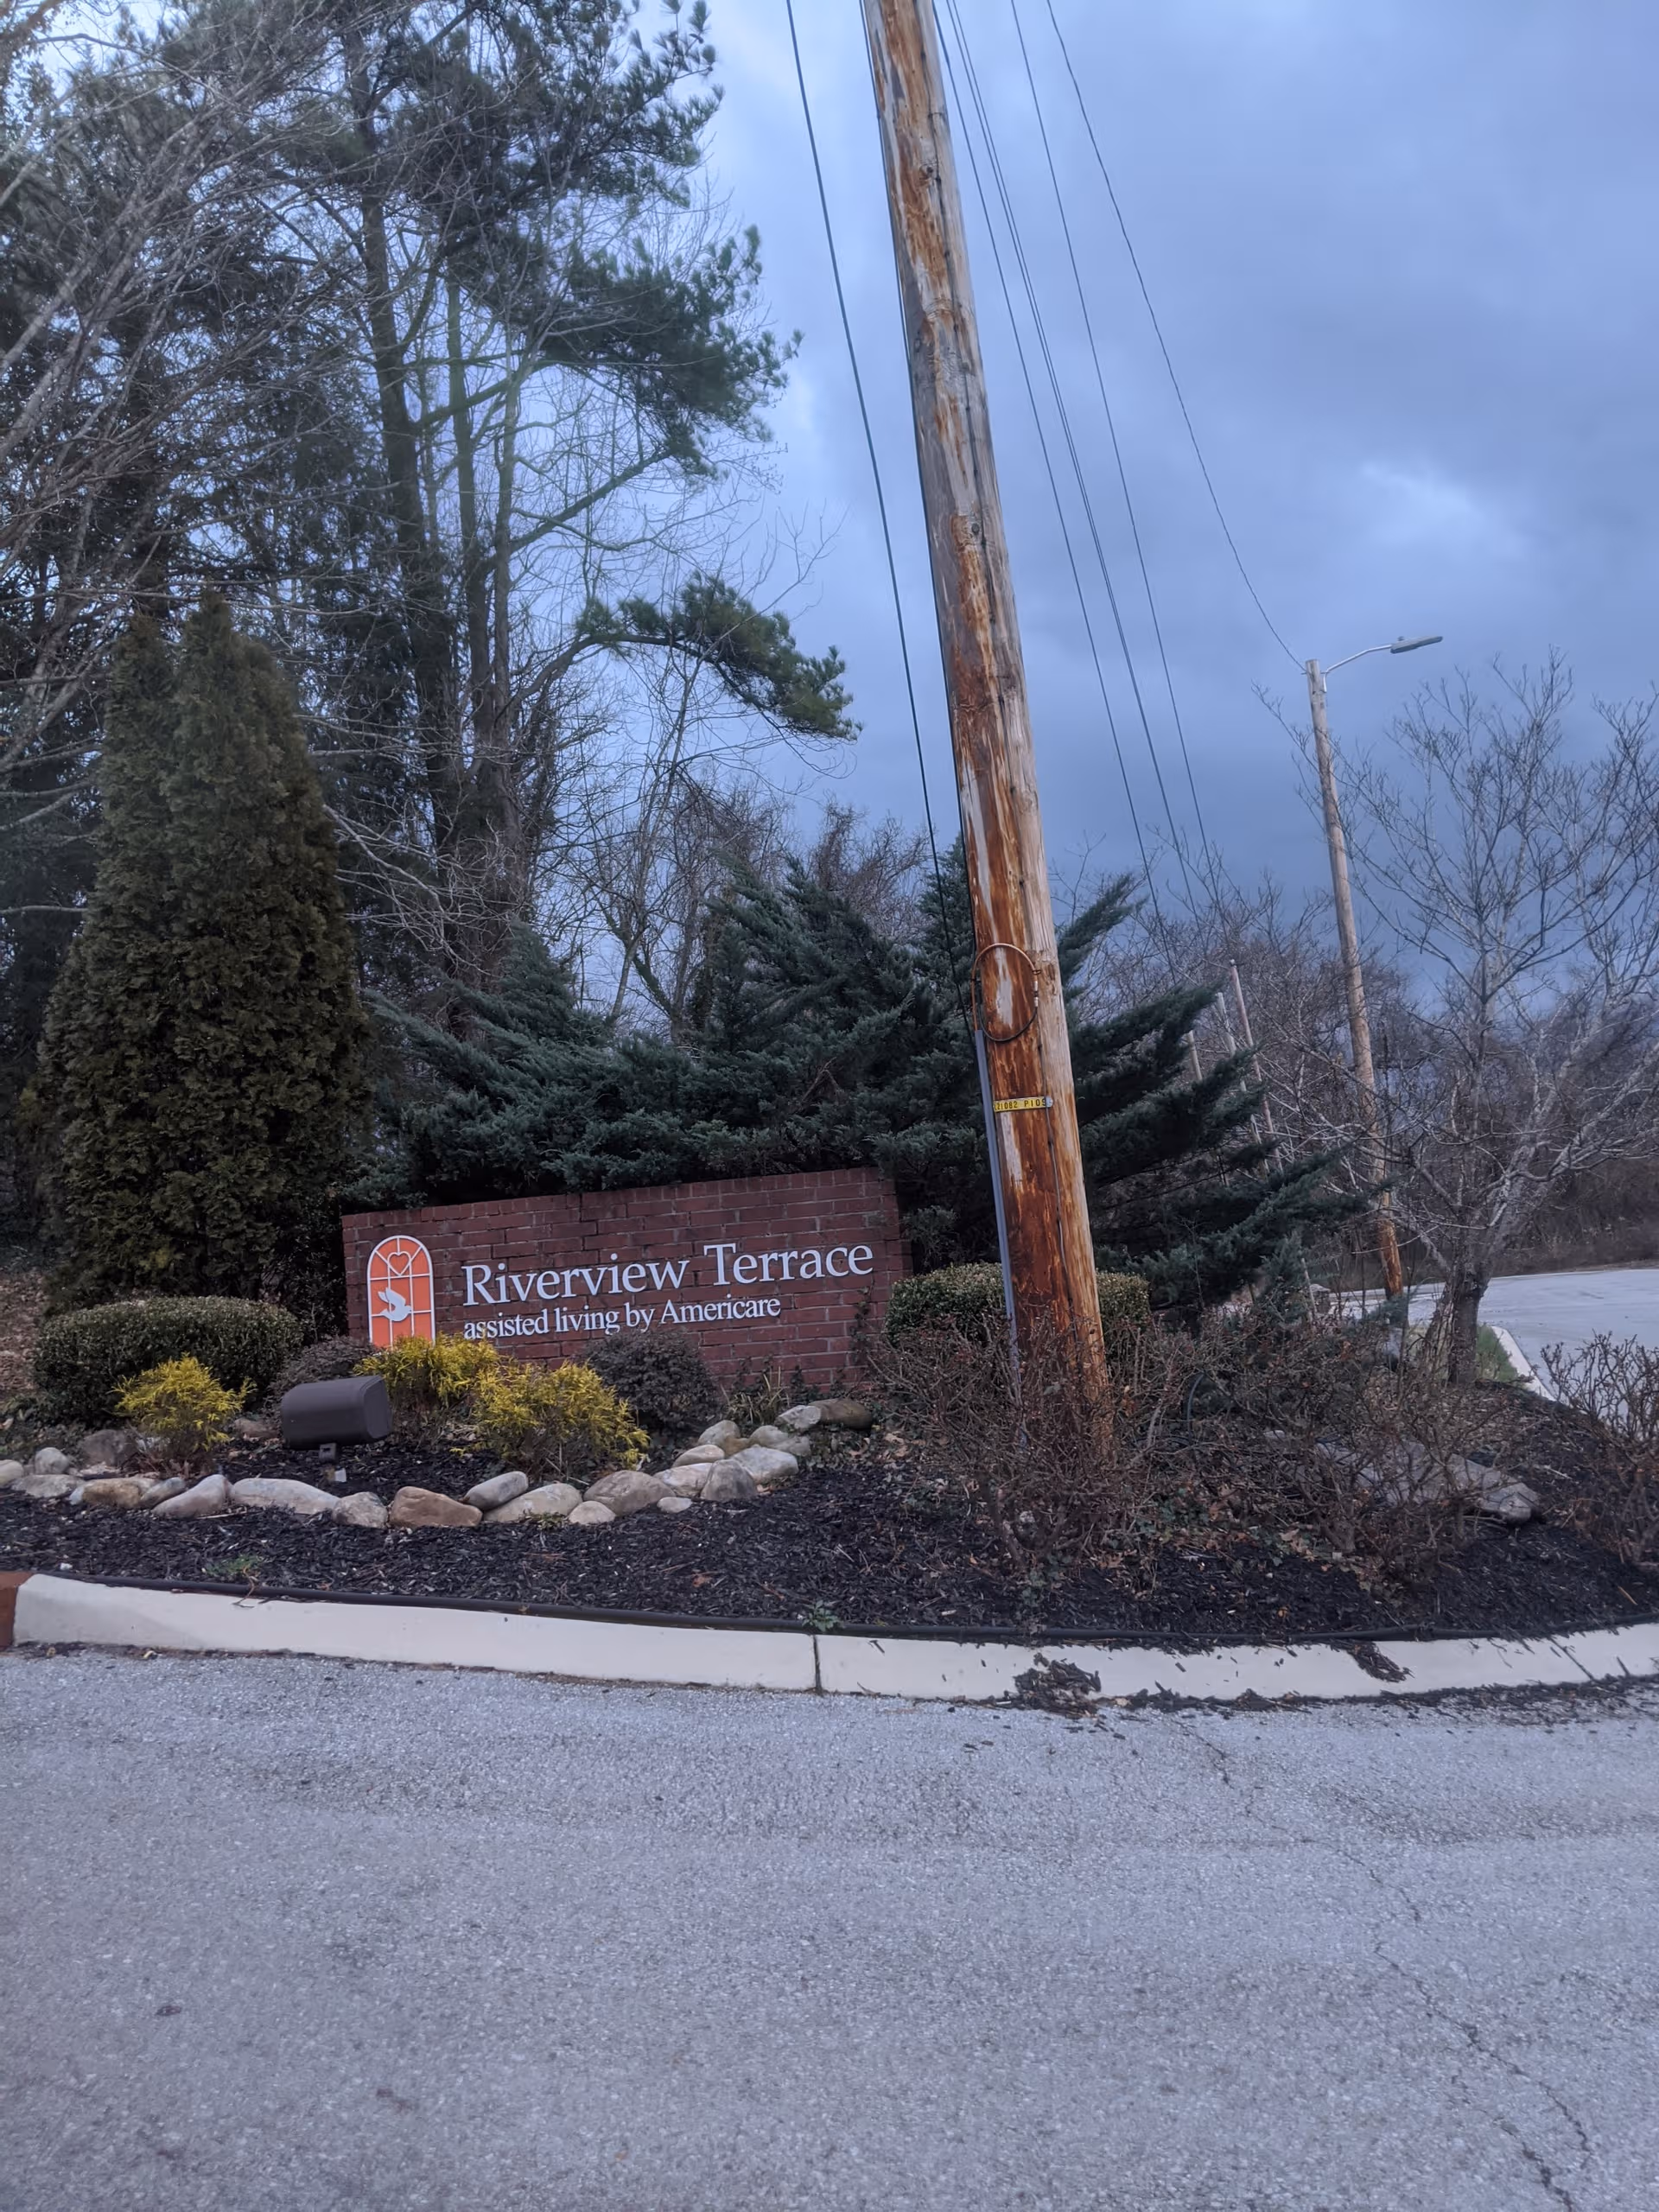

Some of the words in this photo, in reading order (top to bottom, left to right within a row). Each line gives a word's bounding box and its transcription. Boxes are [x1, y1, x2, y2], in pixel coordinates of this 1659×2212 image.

[461, 1253, 690, 1306] Riverview
[703, 1243, 874, 1287] Terrace
[463, 1307, 550, 1340] assisted
[555, 1305, 620, 1336] living
[624, 1302, 655, 1333] by
[660, 1294, 782, 1325] Americare
